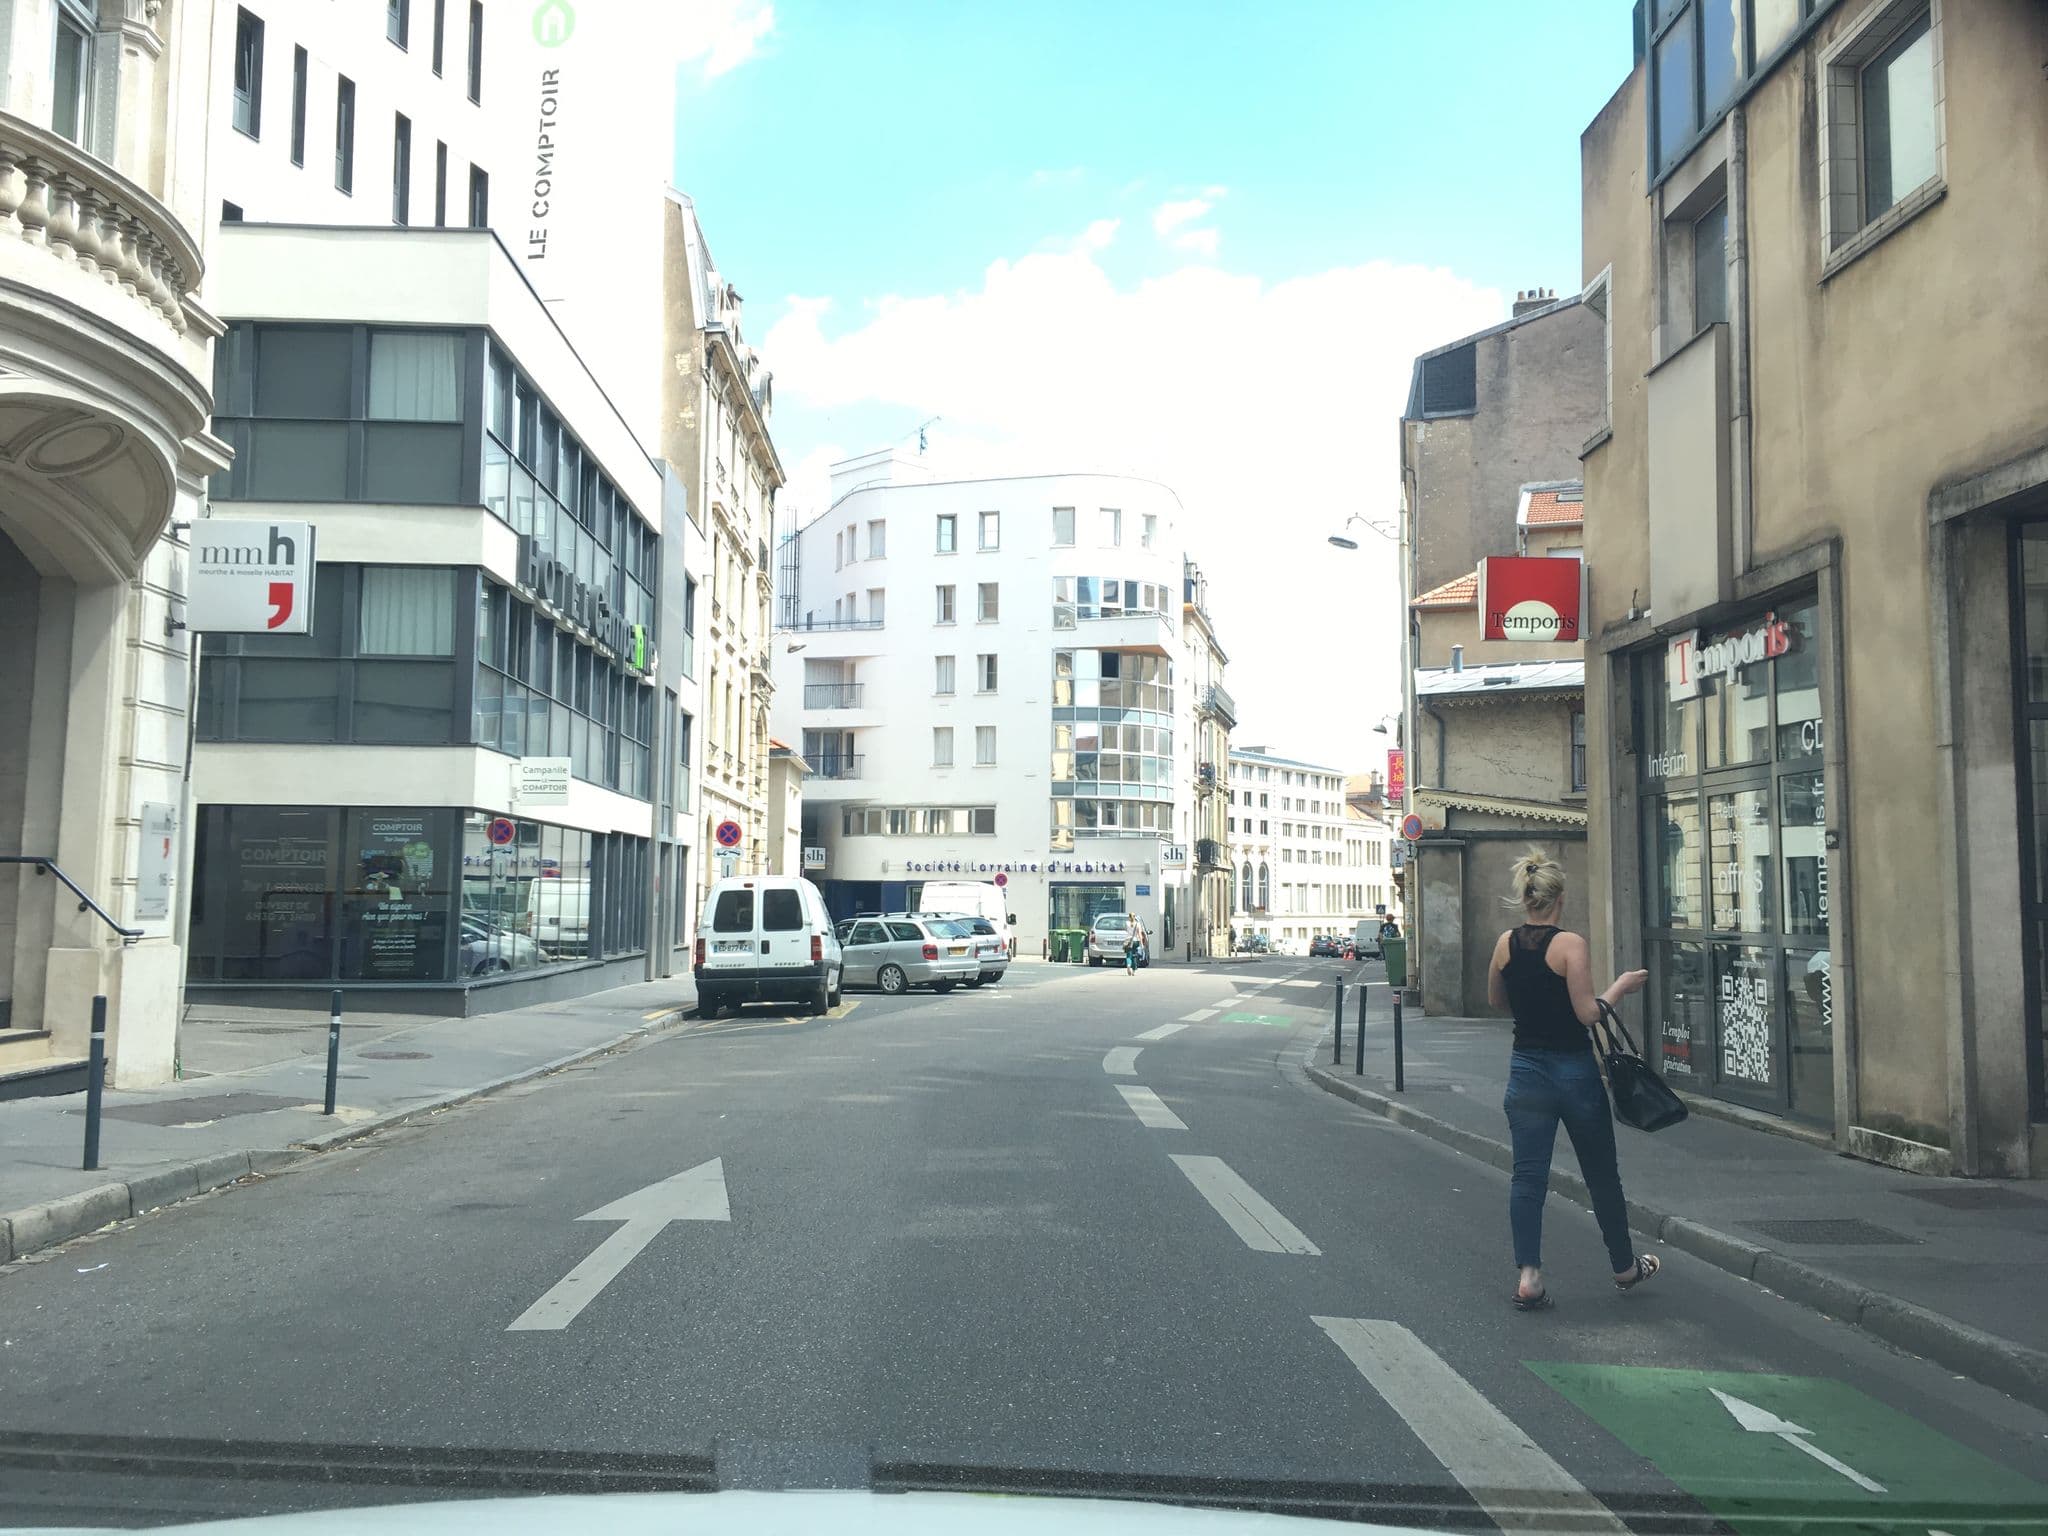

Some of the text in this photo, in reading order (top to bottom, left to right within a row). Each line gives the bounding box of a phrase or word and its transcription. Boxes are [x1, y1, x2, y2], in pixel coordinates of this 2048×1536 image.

[528, 68, 560, 259] LE COMPTOIR
[199, 526, 295, 565] mmh
[264, 569, 294, 577] HABITAT
[1492, 612, 1575, 634] Temporis
[1674, 611, 1790, 686] Temporis
[522, 766, 568, 776] Campanile
[1649, 750, 1688, 778] Intérim
[372, 823, 423, 831] COMPTOIR
[241, 848, 327, 862] COMPTOIR
[806, 849, 824, 861] slh
[1163, 847, 1184, 860] slh
[906, 860, 960, 872] Société
[971, 860, 1037, 872] Lorraine
[1662, 1021, 1690, 1042] L'emploi
